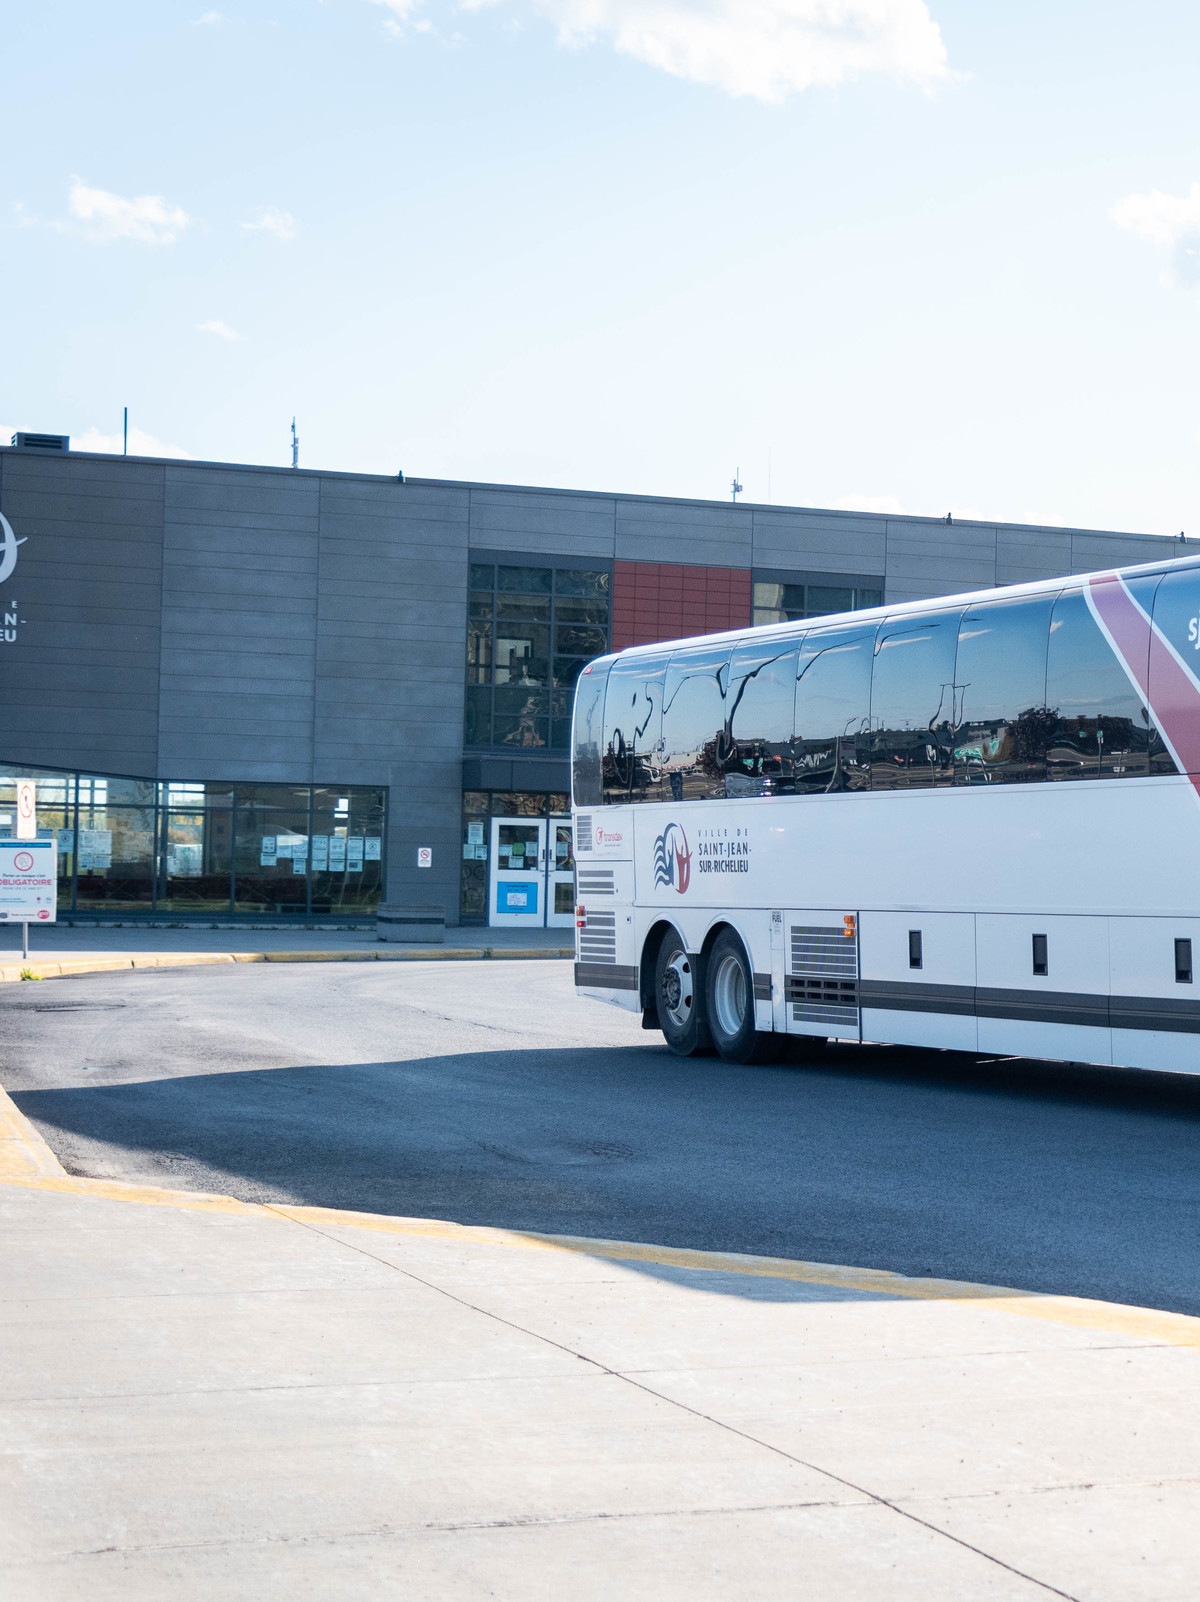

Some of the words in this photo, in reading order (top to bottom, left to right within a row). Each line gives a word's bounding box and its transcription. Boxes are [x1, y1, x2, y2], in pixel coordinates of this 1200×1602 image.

[698, 829, 728, 837] VILLE
[736, 828, 748, 837] DE
[698, 842, 752, 858] SAINT-JEAN-
[699, 859, 749, 873] SUR-RICHELIEU
